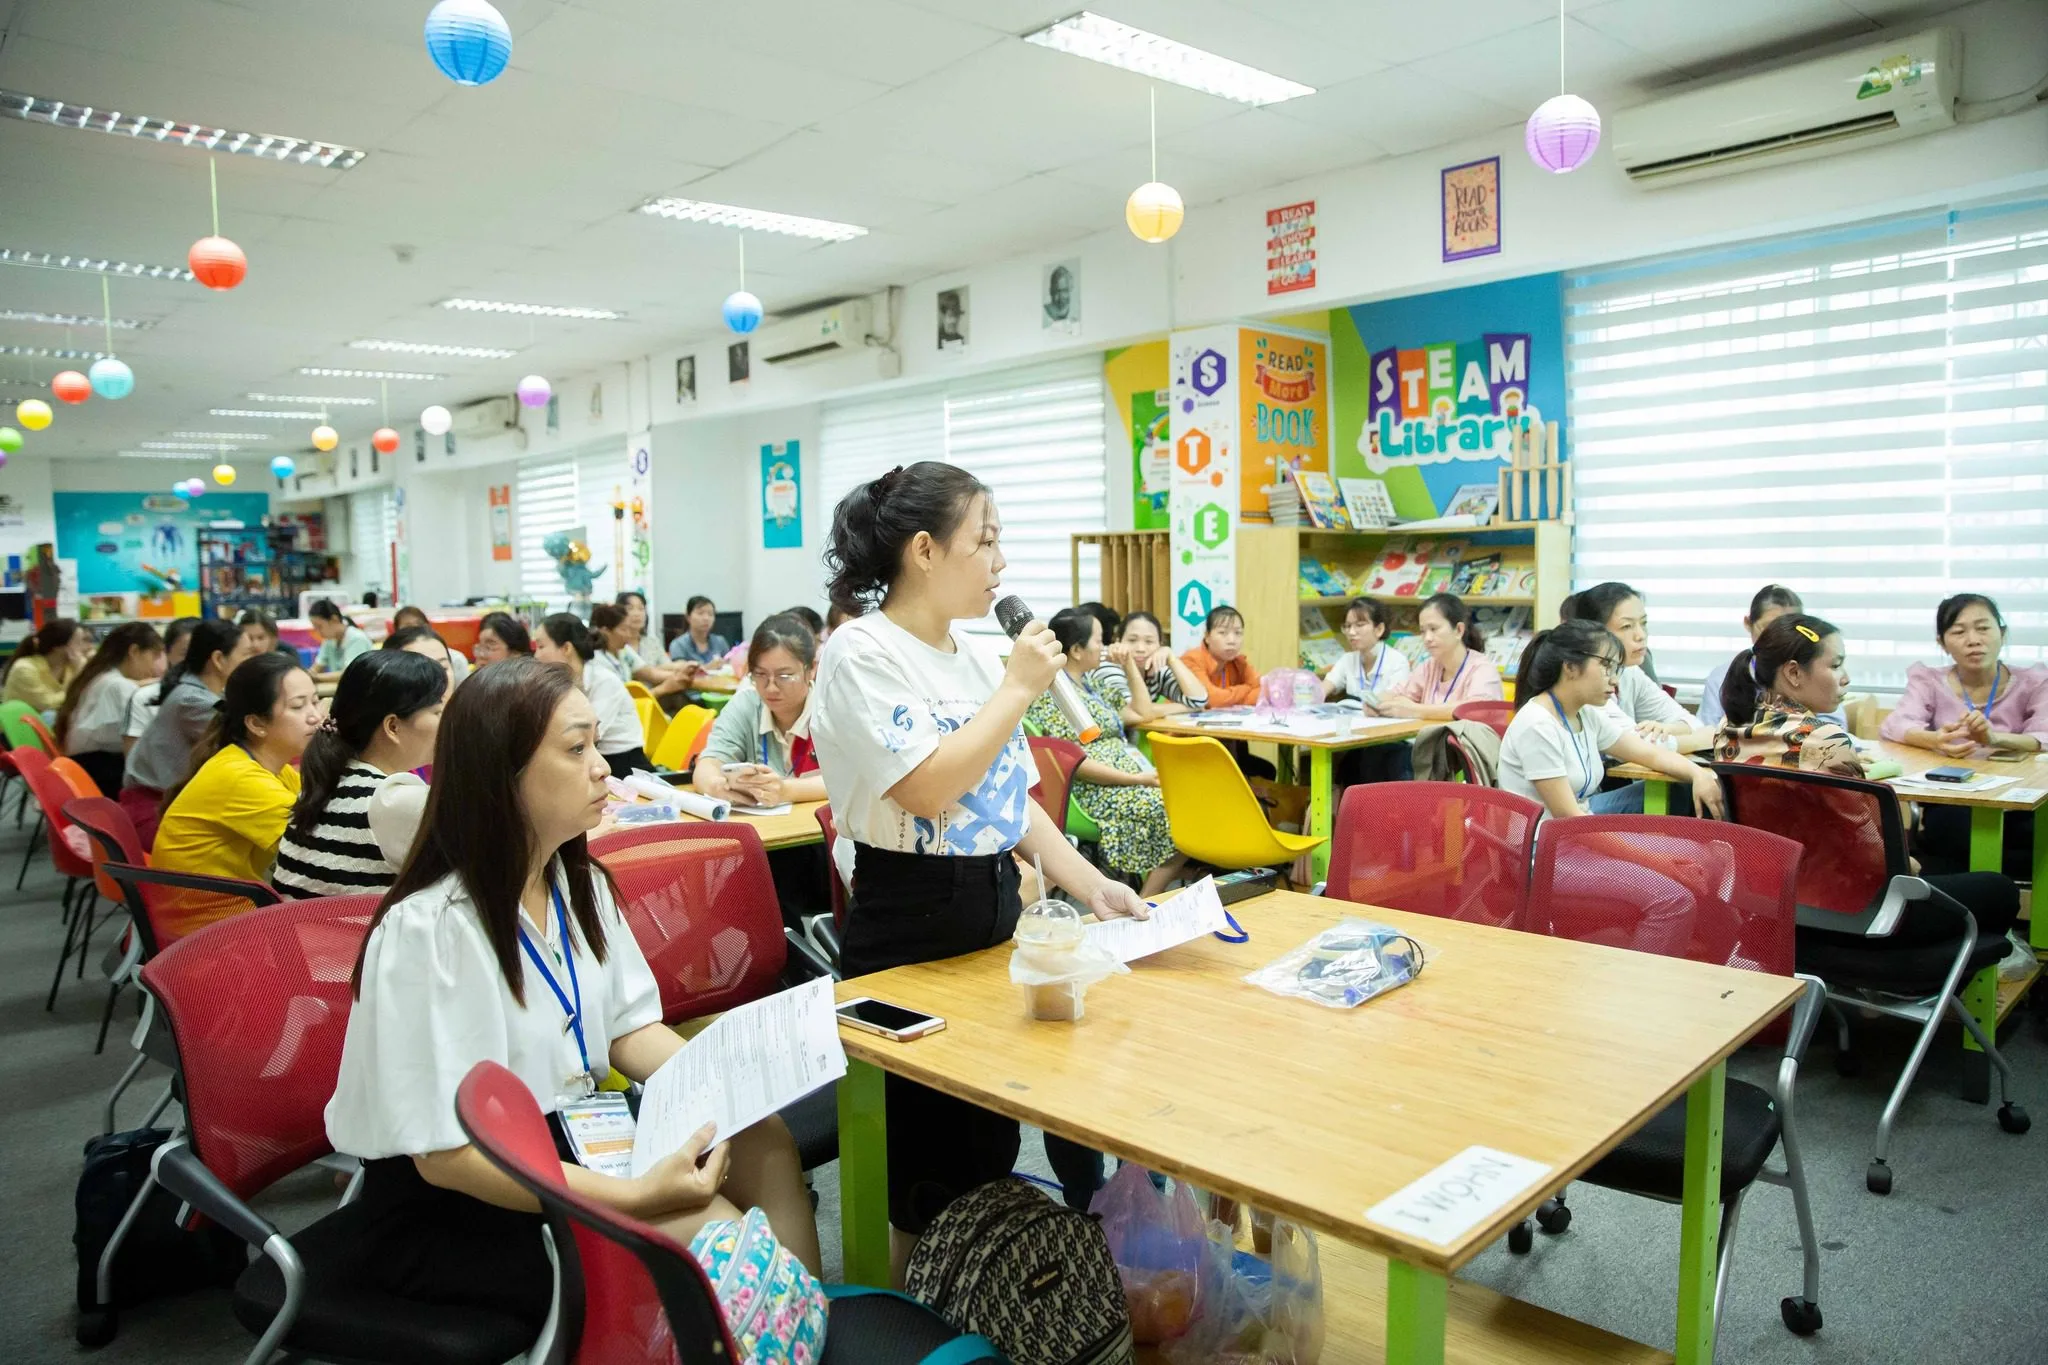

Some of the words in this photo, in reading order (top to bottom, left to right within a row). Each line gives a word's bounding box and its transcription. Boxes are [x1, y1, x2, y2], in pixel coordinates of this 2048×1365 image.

[1200, 355, 1219, 388] S
[1268, 351, 1304, 371] READ
[1376, 340, 1526, 408] STEAM
[1256, 402, 1317, 447] BOOK
[1185, 436, 1203, 467] T
[1203, 511, 1218, 541] E
[1182, 587, 1206, 617] A
